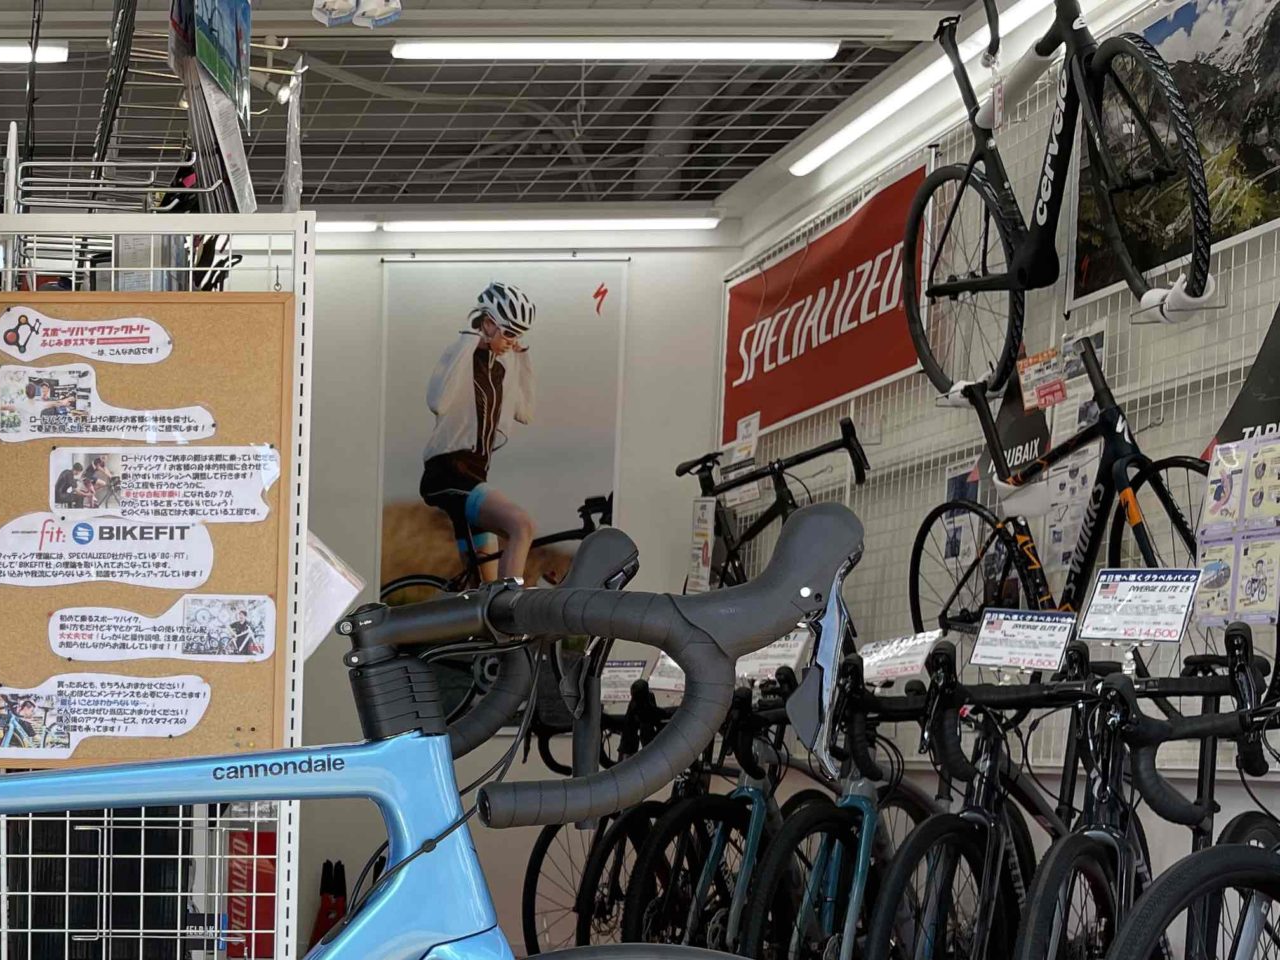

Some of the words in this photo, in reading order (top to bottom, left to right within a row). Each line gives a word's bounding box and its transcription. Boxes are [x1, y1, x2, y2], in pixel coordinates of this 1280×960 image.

[733, 241, 904, 387] SPECIALIZED
[42, 325, 150, 337] スポーツバイクファクトリー
[98, 525, 191, 541] BIKEFIT
[1064, 482, 1105, 600] S-WORKS
[212, 754, 345, 780] cannondale
